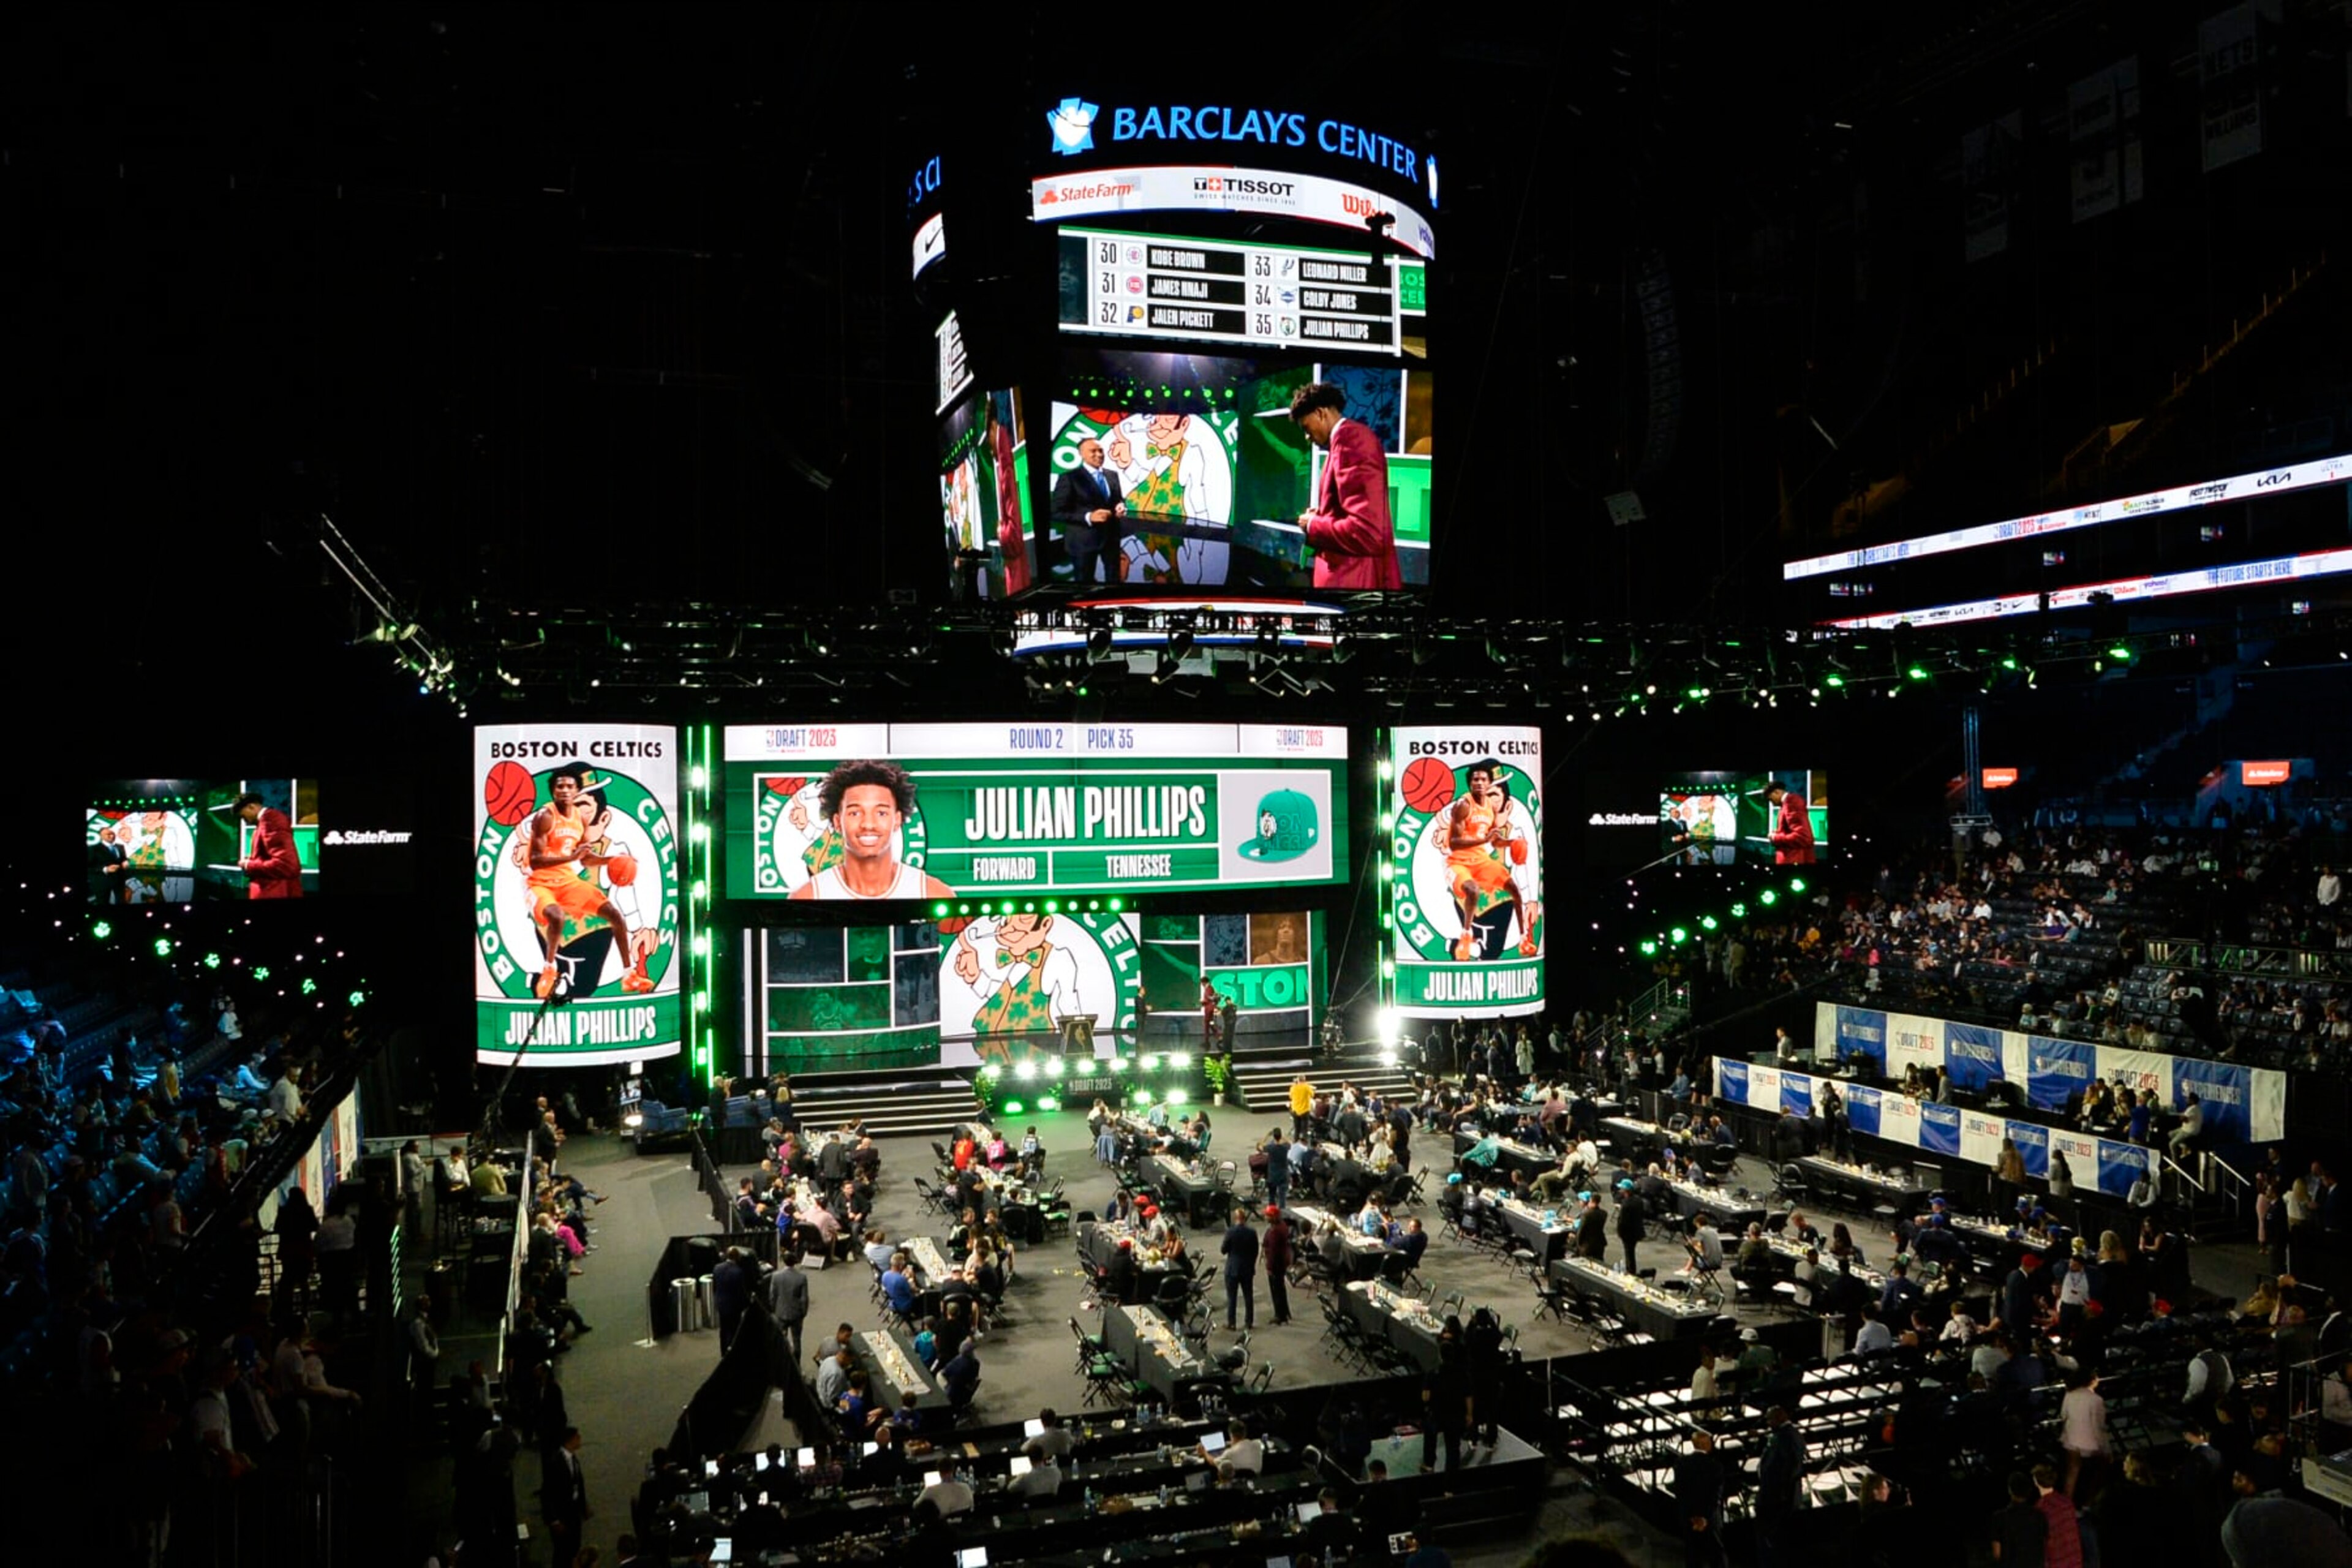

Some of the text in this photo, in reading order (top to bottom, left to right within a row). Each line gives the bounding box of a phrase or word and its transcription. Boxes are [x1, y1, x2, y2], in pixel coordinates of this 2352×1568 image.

[1112, 106, 1418, 184] BARCLAYS CENTER
[1223, 178, 1294, 196] TISSOT
[1101, 243, 1117, 263] 30
[1255, 255, 1271, 276] 33
[1102, 273, 1115, 293] 31
[1256, 285, 1271, 306] 34
[1101, 302, 1117, 323] 32
[1256, 314, 1272, 334] 35
[775, 728, 836, 747] DRAFT 2023
[1011, 729, 1064, 749] ROUND 2
[1088, 729, 1134, 748] PICK 35
[1409, 741, 1539, 755] BOSTON CELTICS
[491, 741, 662, 759] BOSTON CELTICS
[965, 786, 1207, 841] JULIAN PHILLIPS
[637, 797, 679, 948] CELTICS
[973, 858, 1036, 881] FORWARD
[1105, 854, 1172, 878] TENNESSEE
[477, 827, 514, 984] BOSTON
[1424, 967, 1539, 1001] JULIAN PHILLIPS
[505, 1006, 657, 1046] JULIAN PHILLIPS
